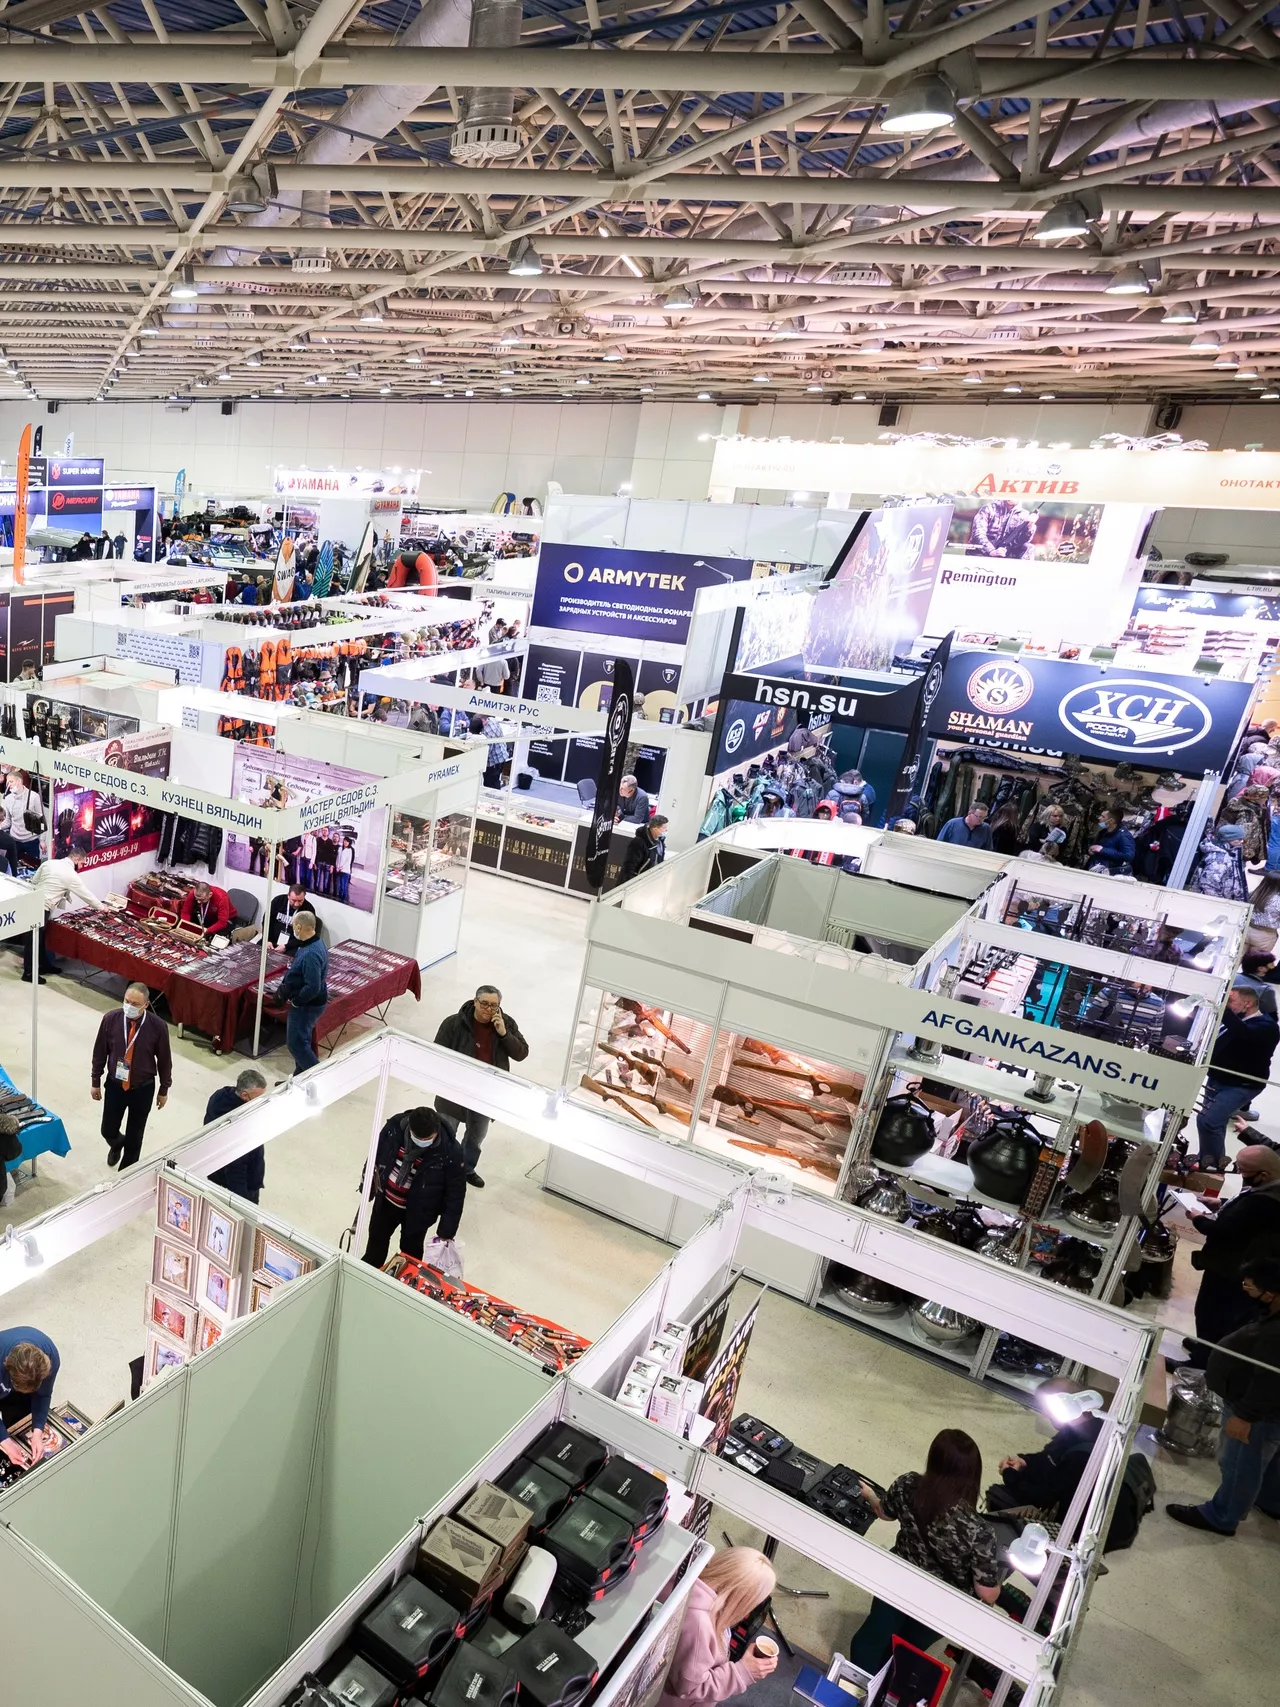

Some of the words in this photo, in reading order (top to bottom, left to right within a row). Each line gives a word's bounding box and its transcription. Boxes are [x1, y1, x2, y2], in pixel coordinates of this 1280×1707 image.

[62, 467, 79, 475] SUPER
[80, 467, 101, 475] MARINE
[296, 477, 340, 491] YAMAHA
[65, 496, 99, 504] MERCURY
[114, 489, 140, 500] YAMAHA
[587, 567, 687, 592] ARMYTEK
[940, 568, 1017, 586] Remington
[560, 596, 612, 609] ПРОИЗВОДИТЕЛЬ
[612, 601, 664, 614] СВЕТОДИОДНЫХ
[559, 605, 591, 617] ЗАРЯДНЫХ
[591, 608, 626, 621] УСТРОЙСТВ
[632, 613, 677, 626] АКСЕССУАРОВ
[754, 679, 858, 717] hsn.su
[947, 724, 963, 732] your
[963, 725, 994, 738] personal
[994, 730, 1027, 742] guardian
[948, 711, 1034, 736] SHAMAN
[1085, 722, 1129, 735] РОССИЯ
[428, 764, 461, 784] PYRAMEX
[53, 760, 92, 780] МАСТЕР
[94, 771, 128, 791] СЕДОВ
[130, 782, 150, 798] С.З.
[161, 790, 203, 815] КУЗНЕЦ
[206, 803, 263, 830] ВЯЛЬДИН
[299, 797, 334, 819] МАСТЕР
[335, 789, 363, 807] СЕДОВ
[365, 785, 379, 797] С.З.
[303, 812, 336, 831] КУЗНЕЦ
[337, 798, 376, 821] ВЯЛЬДИН
[921, 1009, 1160, 1092] AFGANKAZANS.ru
[1160, 1102, 1186, 1115] N3.1
